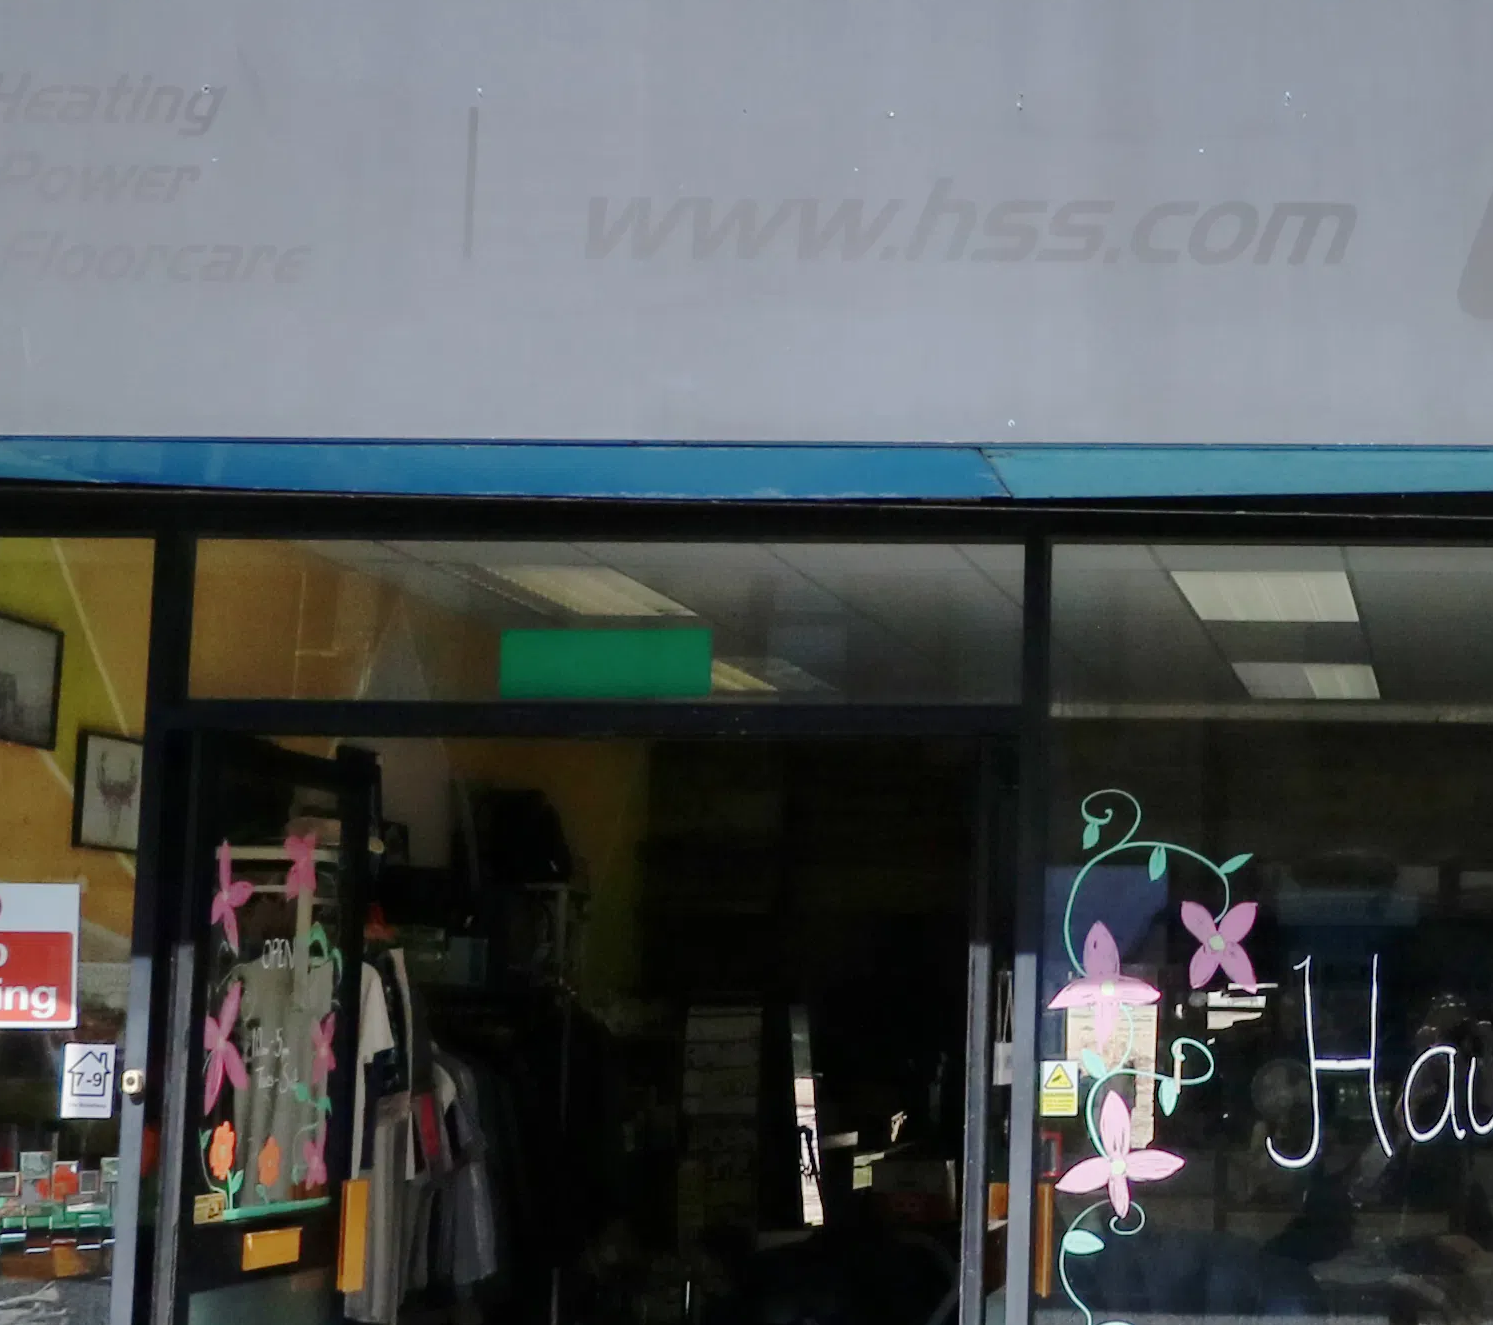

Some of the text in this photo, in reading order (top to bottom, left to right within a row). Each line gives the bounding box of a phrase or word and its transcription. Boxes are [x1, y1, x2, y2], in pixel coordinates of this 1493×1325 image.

[582, 176, 1360, 267] www.hss.com
[261, 937, 297, 970] OPEN
[75, 1072, 102, 1087] 7-9
